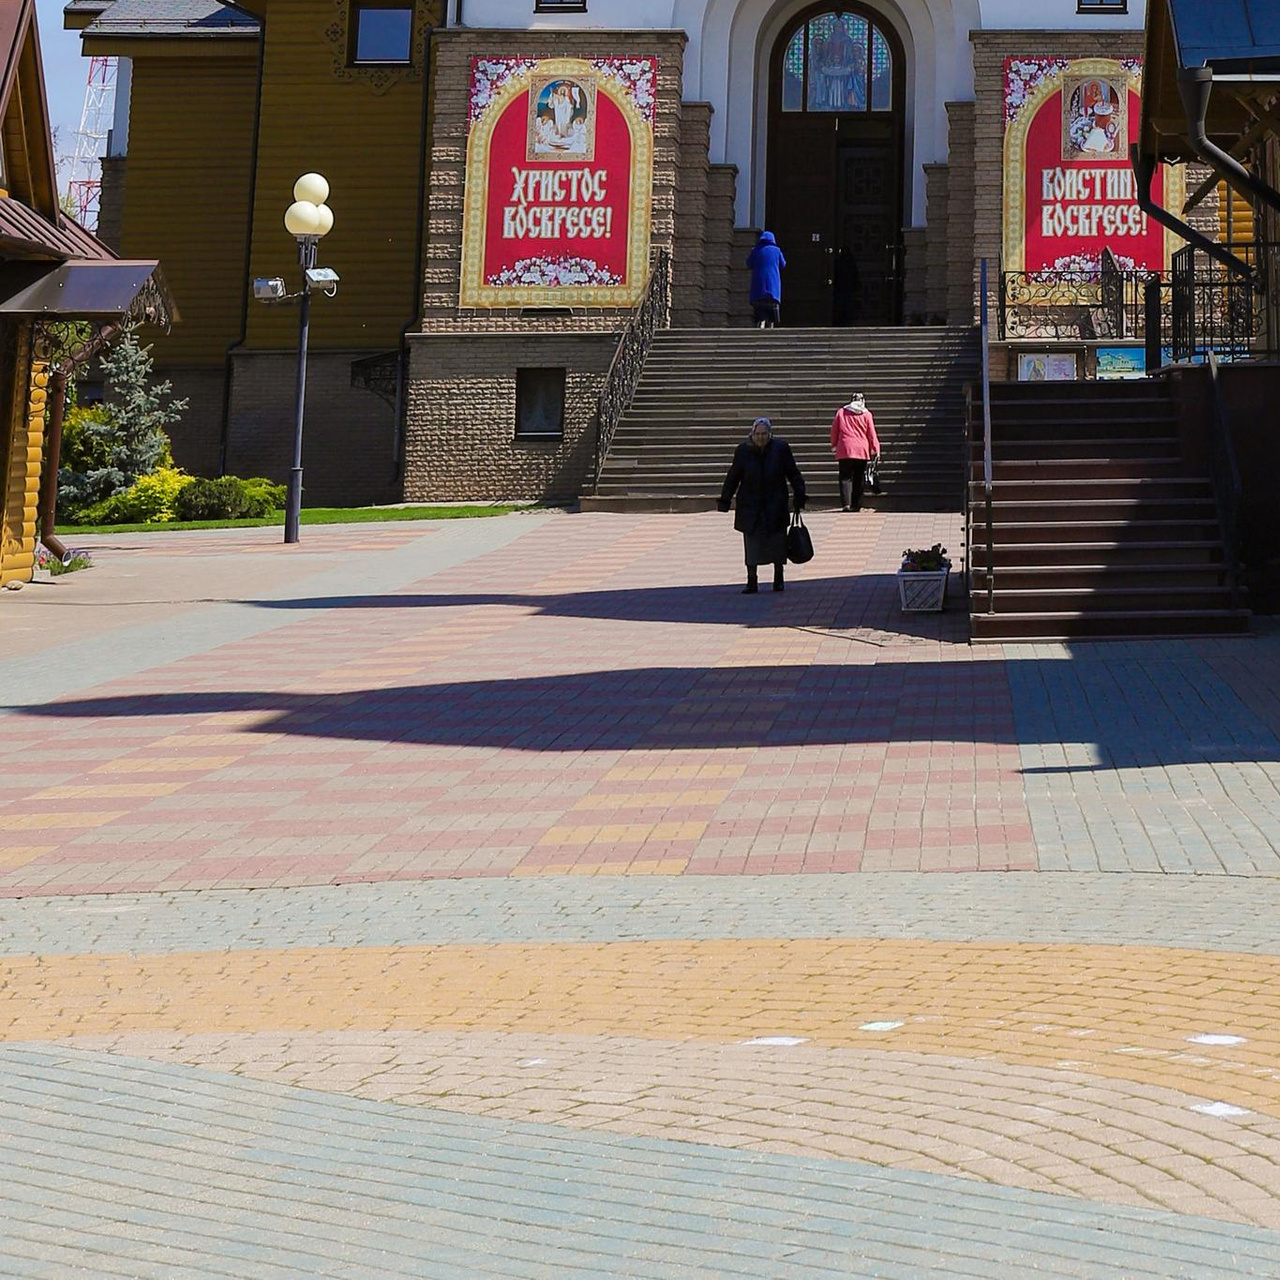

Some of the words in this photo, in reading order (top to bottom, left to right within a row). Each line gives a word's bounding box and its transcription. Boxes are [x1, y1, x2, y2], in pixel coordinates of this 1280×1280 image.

[510, 166, 607, 207] ХРИСТОС
[502, 204, 612, 239] ВОСКРЕСЕ!
[1041, 202, 1147, 237] ВОСКРЕСЕ!
